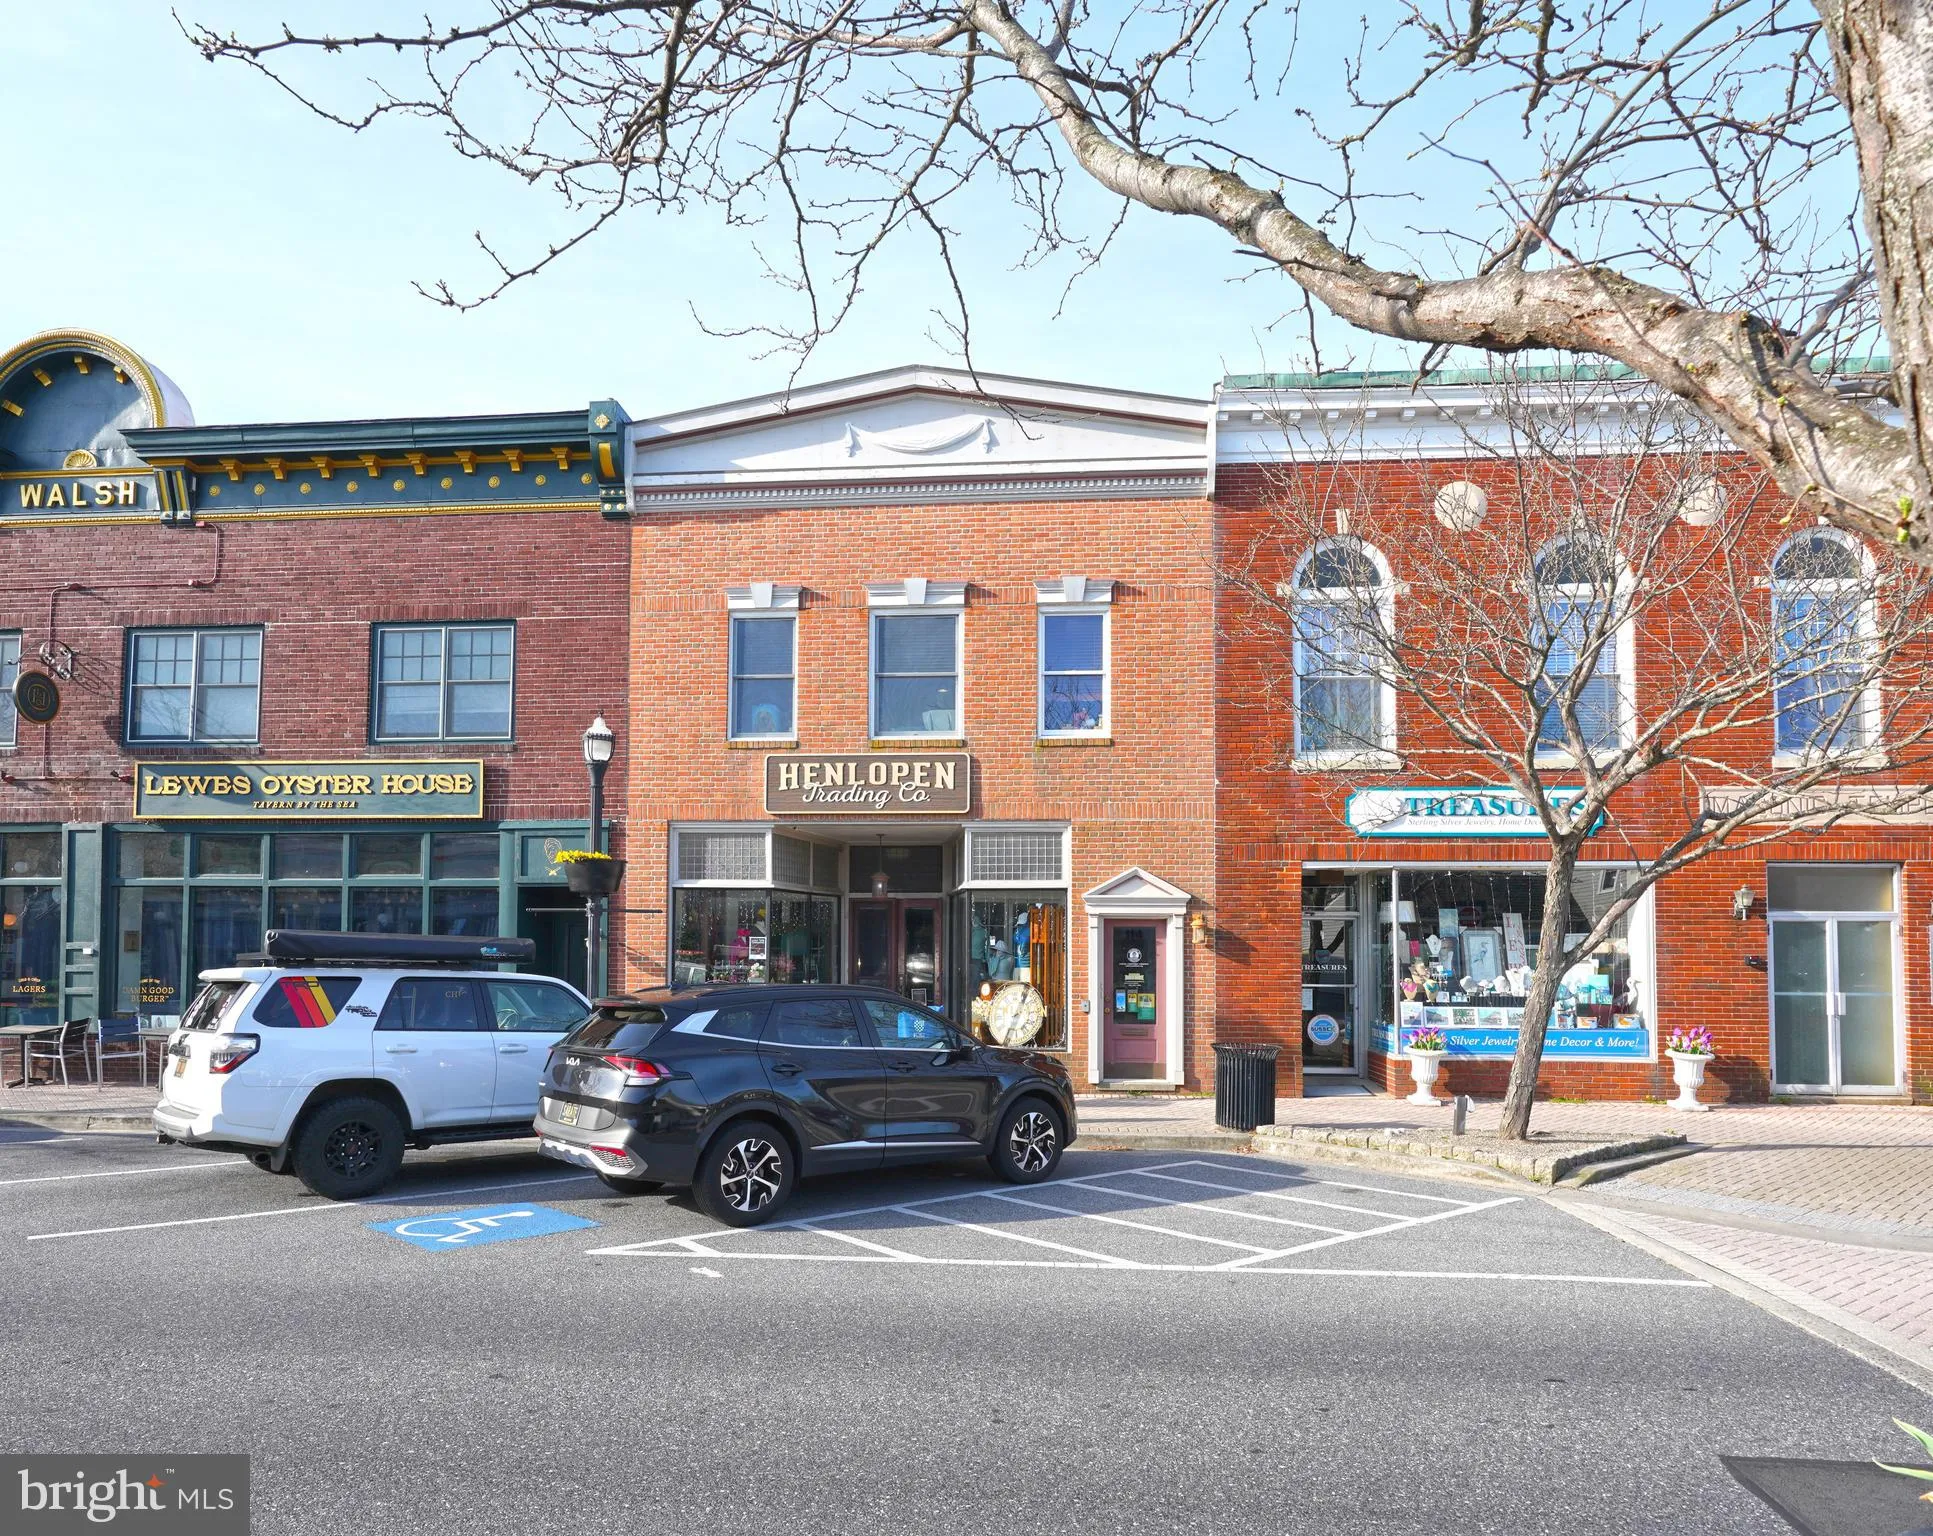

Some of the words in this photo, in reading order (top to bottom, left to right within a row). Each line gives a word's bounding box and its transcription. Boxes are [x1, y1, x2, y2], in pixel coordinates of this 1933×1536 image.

[20, 480, 136, 508] WALSH
[778, 761, 956, 791] HENLOPEN
[144, 775, 252, 796] LEWES
[260, 774, 373, 795] OYSTER
[380, 773, 475, 794] HOUSE
[802, 781, 893, 809] Trading
[898, 781, 932, 803] Co.
[253, 800, 296, 809] TAVERN
[297, 800, 310, 808] BY
[314, 799, 334, 808] THE
[336, 799, 356, 808] SEA
[1408, 817, 1438, 827] Sterling
[1440, 817, 1463, 826] Silver
[12, 985, 46, 993] LAGERS
[149, 986, 175, 994] GOOD
[1450, 1036, 1480, 1047] Silver
[1560, 1036, 1591, 1048] Decor
[1594, 1037, 1605, 1047] &
[1607, 1037, 1640, 1048] More!
